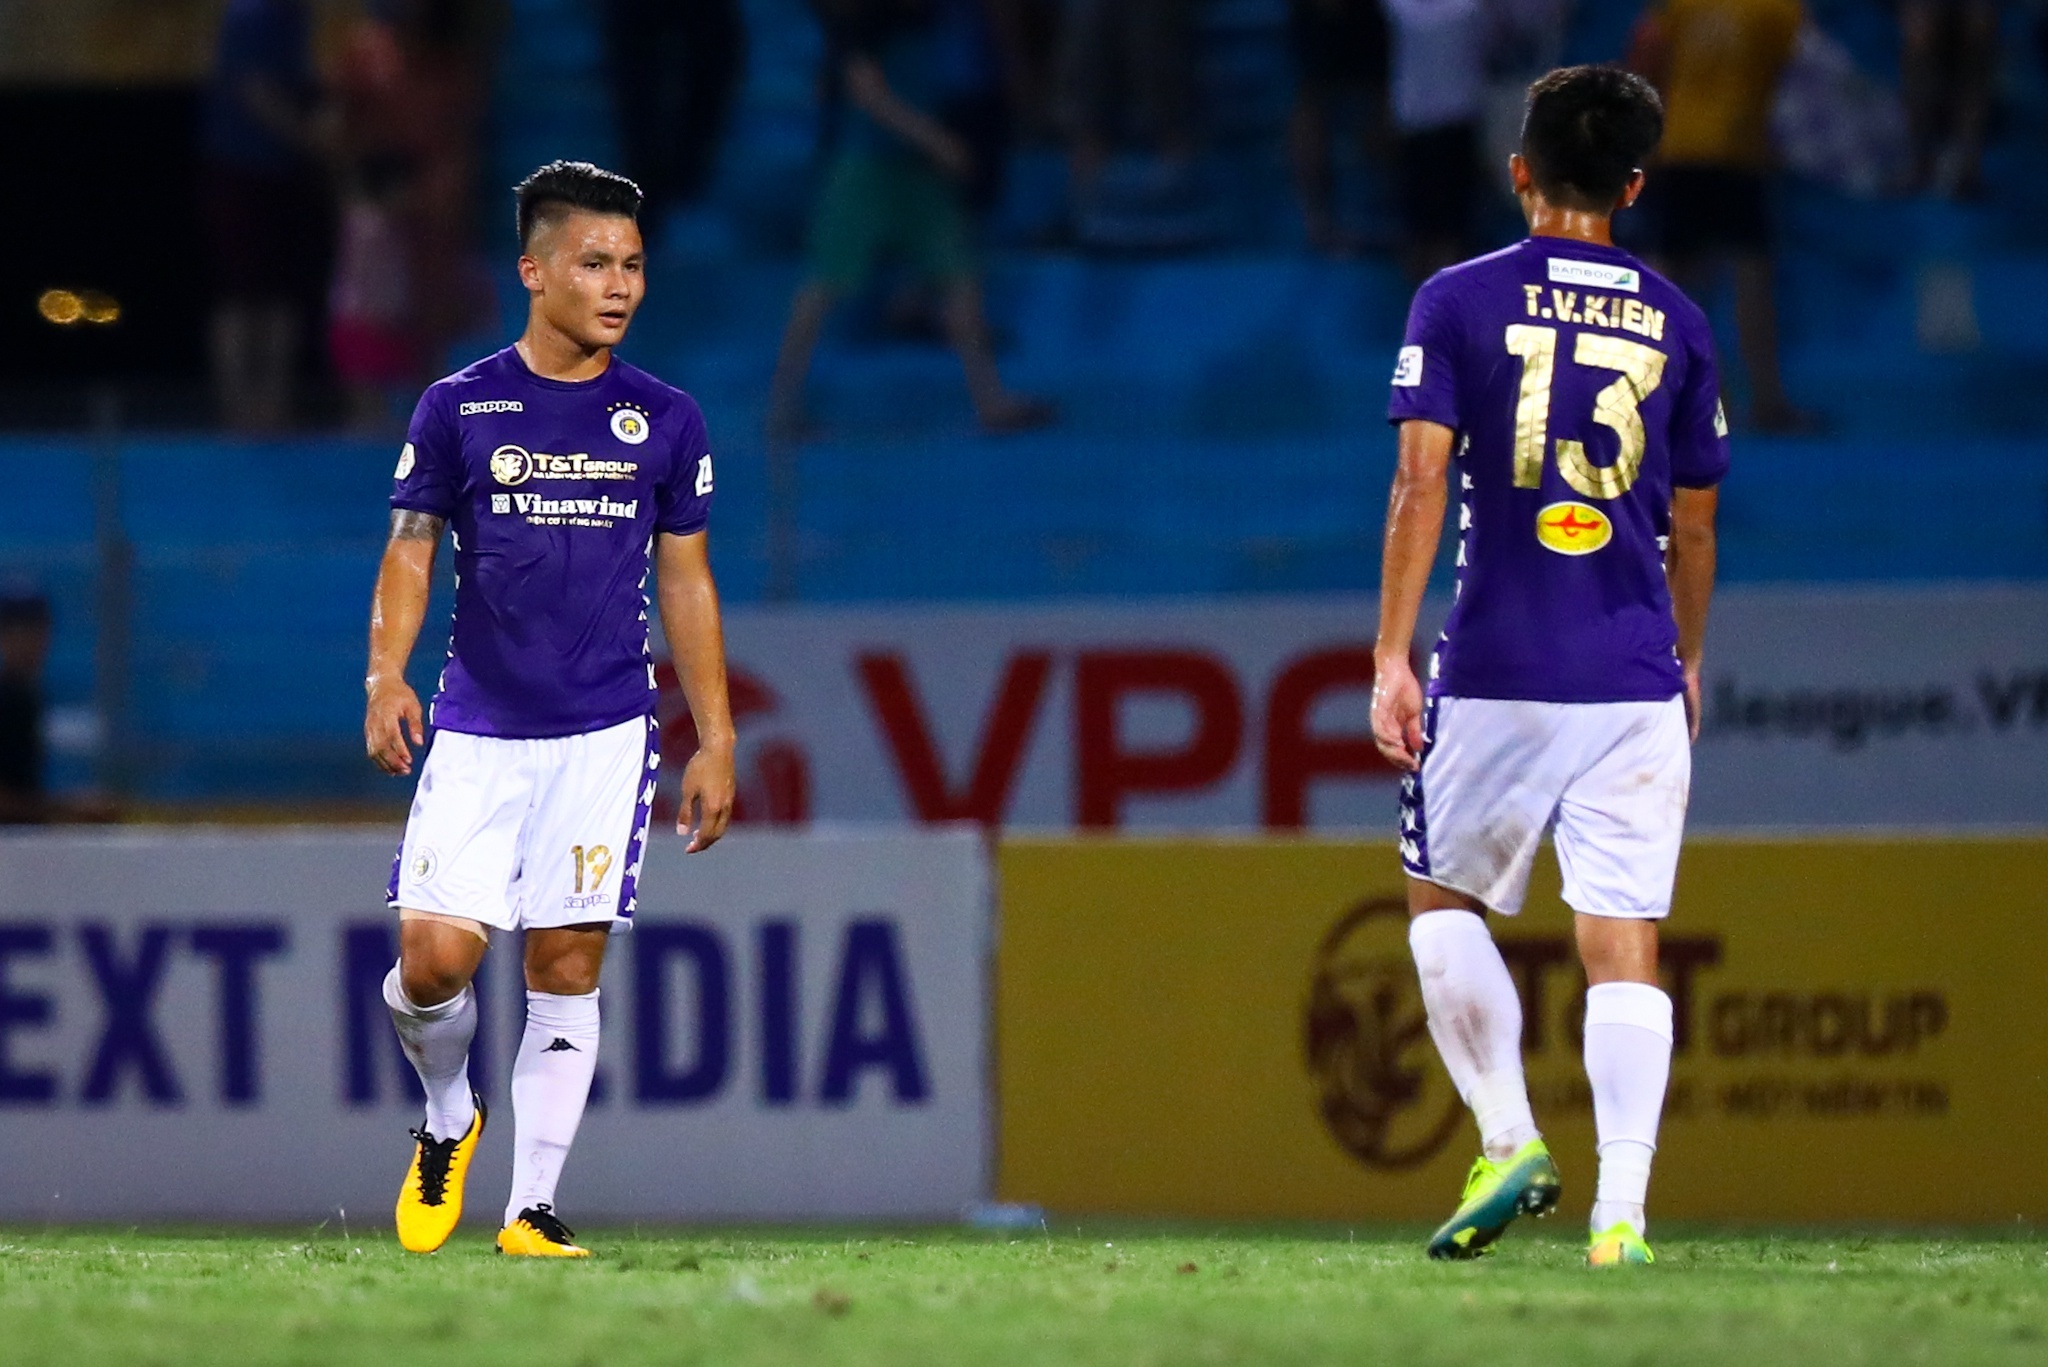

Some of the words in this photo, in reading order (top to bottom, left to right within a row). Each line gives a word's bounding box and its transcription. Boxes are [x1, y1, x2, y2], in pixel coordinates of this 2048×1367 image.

[1551, 265, 1614, 280] BAMBOO
[1523, 284, 1666, 341] T.V.KIEN
[460, 400, 523, 415] Kappa
[1505, 323, 1669, 500] 13
[512, 493, 638, 519] Vinawind
[571, 844, 613, 894] 19
[563, 893, 611, 909] Kappa
